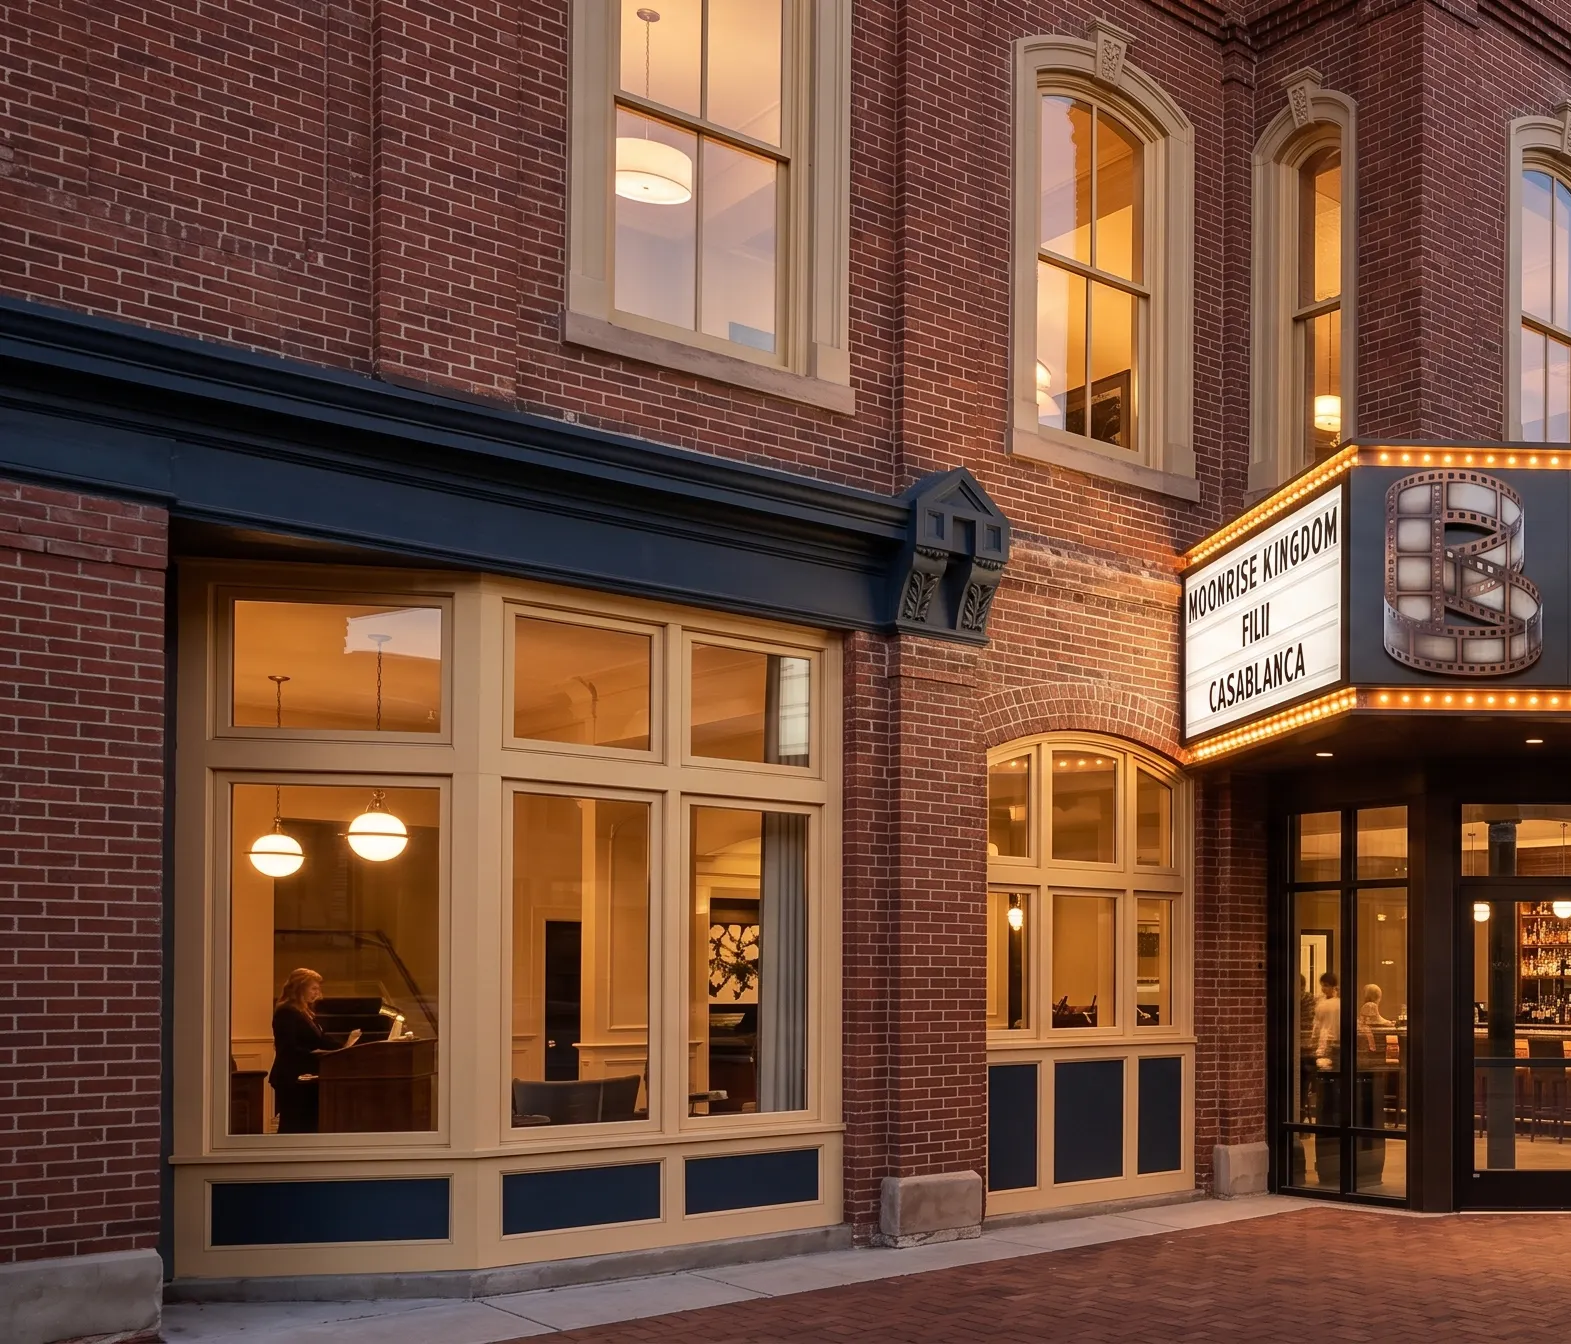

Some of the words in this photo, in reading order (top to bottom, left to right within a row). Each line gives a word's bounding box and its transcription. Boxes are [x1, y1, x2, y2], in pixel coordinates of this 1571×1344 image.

[1188, 554, 1257, 624] MOONRISE
[1263, 506, 1338, 583] KINGDOM
[1242, 602, 1270, 647] FILII
[1209, 642, 1306, 713] CASABLANCA
